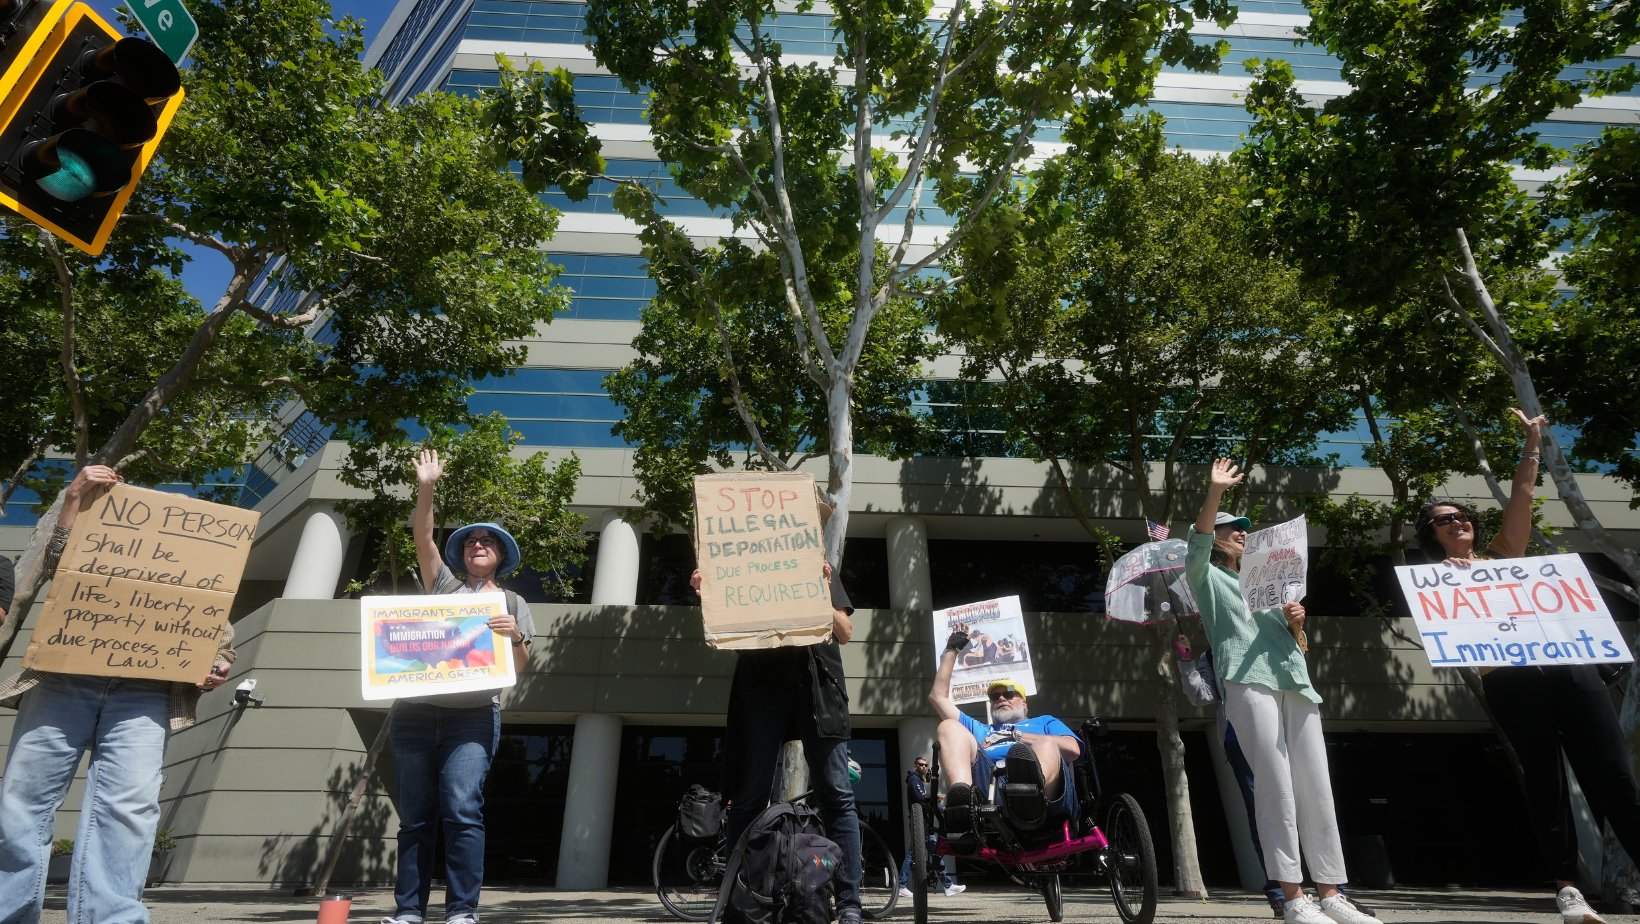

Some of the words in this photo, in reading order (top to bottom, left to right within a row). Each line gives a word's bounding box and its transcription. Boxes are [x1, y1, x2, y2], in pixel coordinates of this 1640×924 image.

[717, 487, 799, 512] STOP
[705, 513, 808, 536] ILLEGAL
[82, 533, 143, 558] Shall
[152, 542, 180, 563] be
[707, 527, 820, 558] DEPORTATION
[79, 557, 187, 587] deprived
[197, 573, 224, 590] of
[716, 566, 741, 580] DUE
[747, 559, 798, 574] PROCESS
[1410, 567, 1461, 589] We
[1471, 565, 1529, 583] are
[1540, 563, 1562, 577] a
[71, 582, 121, 609] life,
[129, 590, 195, 620] liberty
[202, 606, 225, 618] or
[725, 576, 827, 608] REQUIRED!
[1417, 577, 1597, 621] NATION
[64, 608, 146, 635] property
[155, 619, 225, 642] without
[373, 608, 455, 619] IMMIGRANTS
[459, 606, 491, 616] MAKE
[1498, 617, 1518, 632] of
[47, 628, 86, 647] due
[90, 636, 159, 655] process
[166, 640, 193, 657] of
[390, 629, 446, 641] IMMIGRATION
[390, 641, 420, 653] BUILDS
[422, 640, 439, 651] OUR
[1421, 629, 1621, 666] Immigrants
[388, 671, 444, 685] AMERICA
[448, 667, 491, 679] GREAT!
